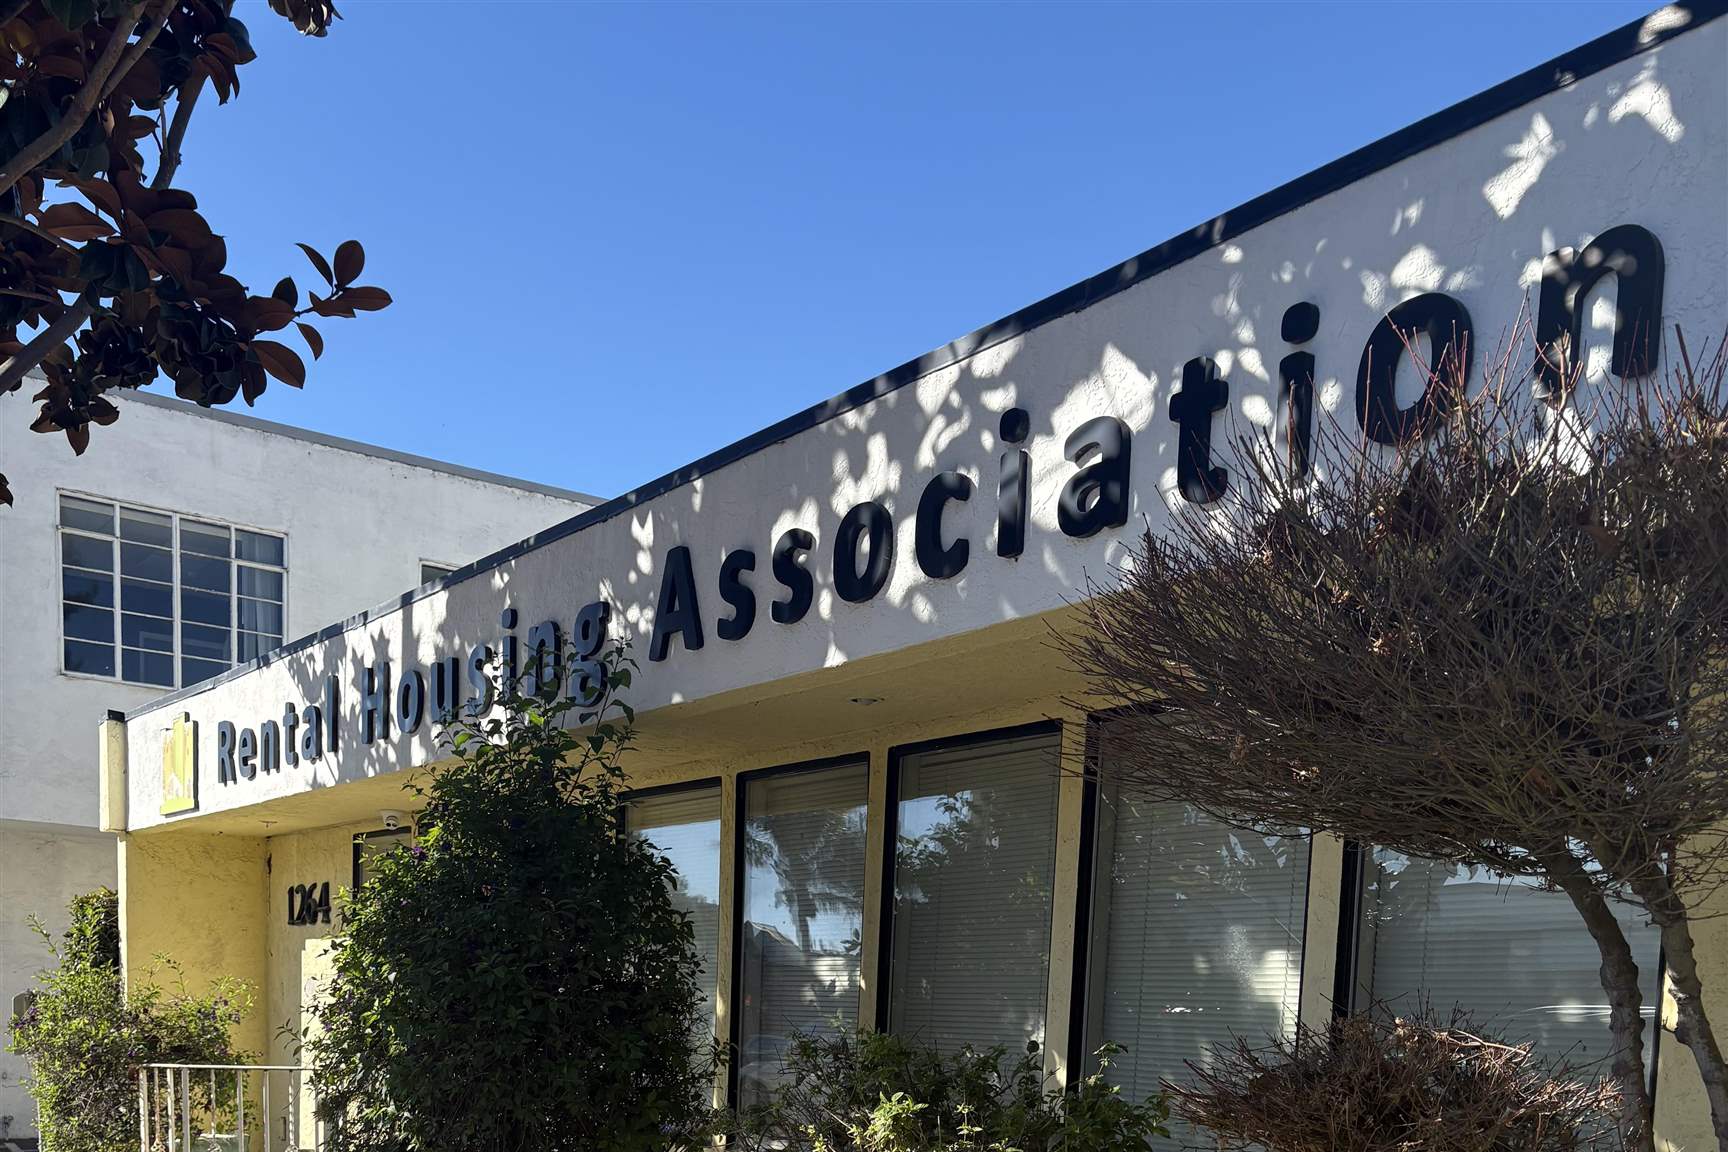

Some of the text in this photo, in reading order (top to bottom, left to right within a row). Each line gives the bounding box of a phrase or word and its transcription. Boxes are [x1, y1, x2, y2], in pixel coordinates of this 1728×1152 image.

[217, 223, 1665, 786] Rental Housing Association
[287, 881, 331, 925] 1264
